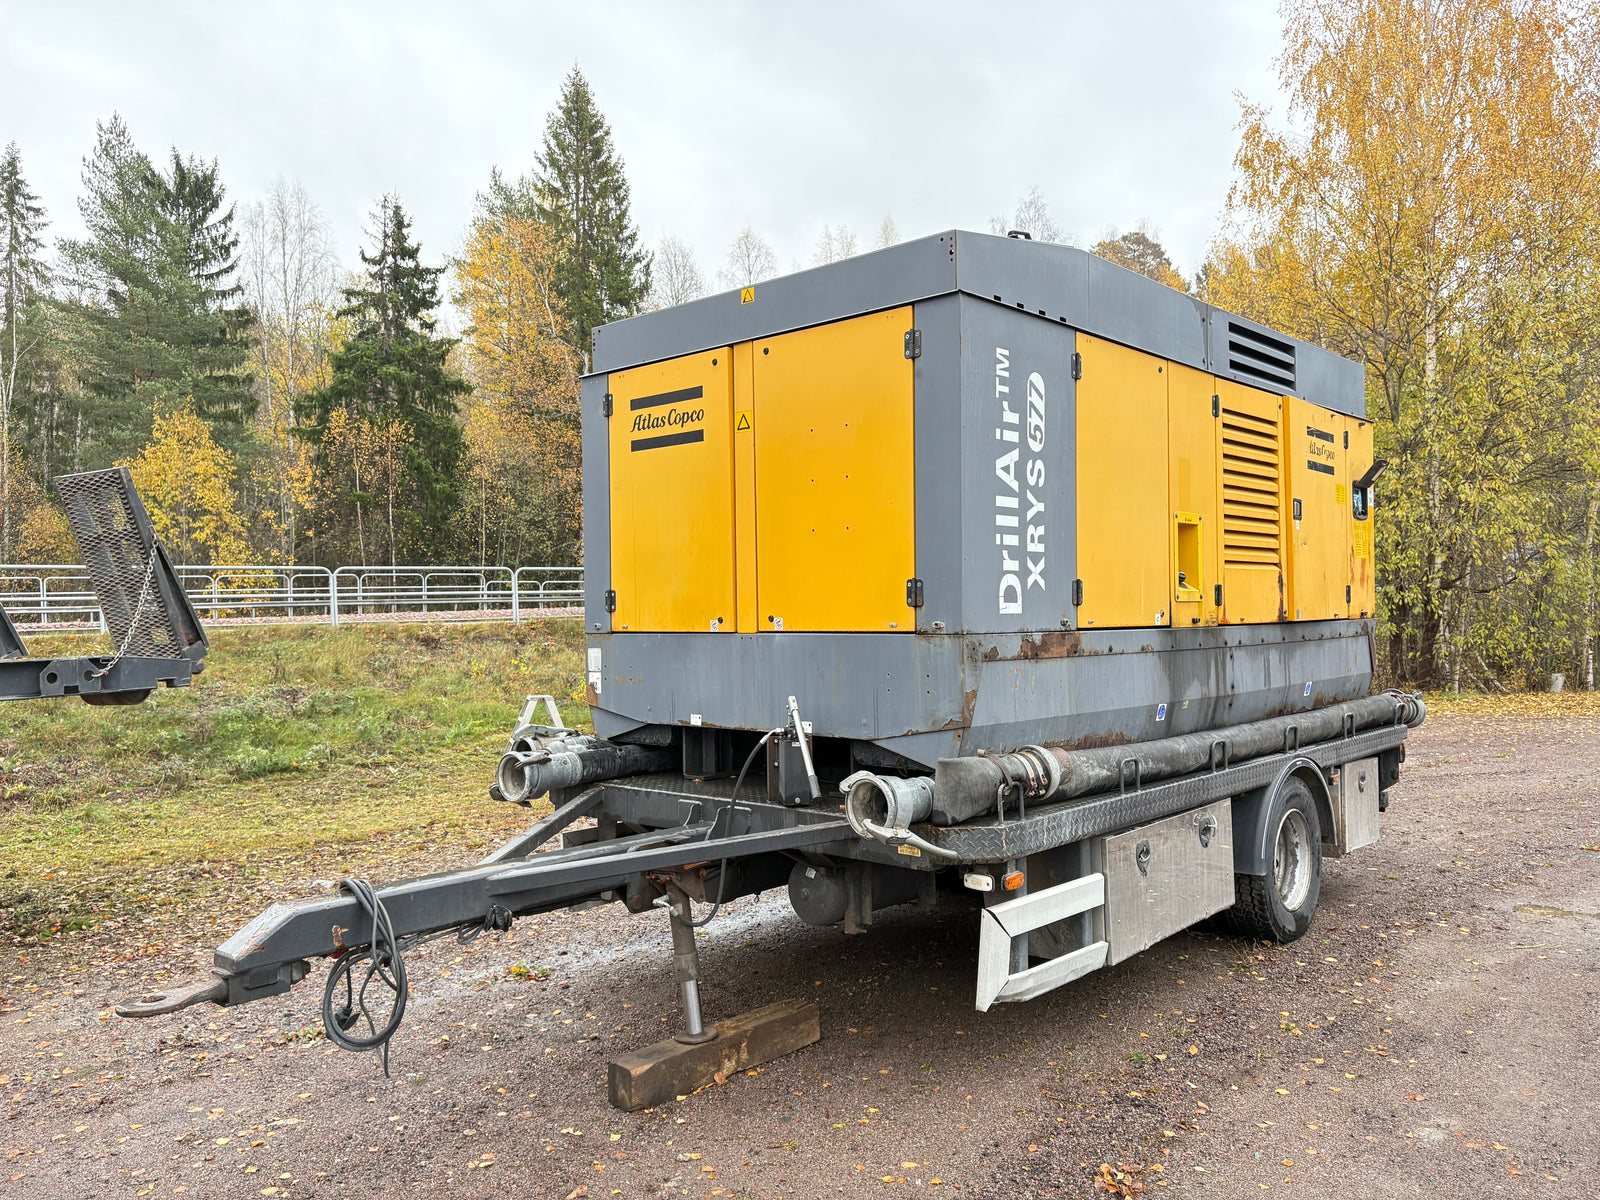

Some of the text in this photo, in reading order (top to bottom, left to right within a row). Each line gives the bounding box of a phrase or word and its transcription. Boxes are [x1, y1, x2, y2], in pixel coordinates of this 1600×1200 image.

[630, 409, 704, 433] Atlas Copco
[1026, 378, 1046, 592] XRYS 577
